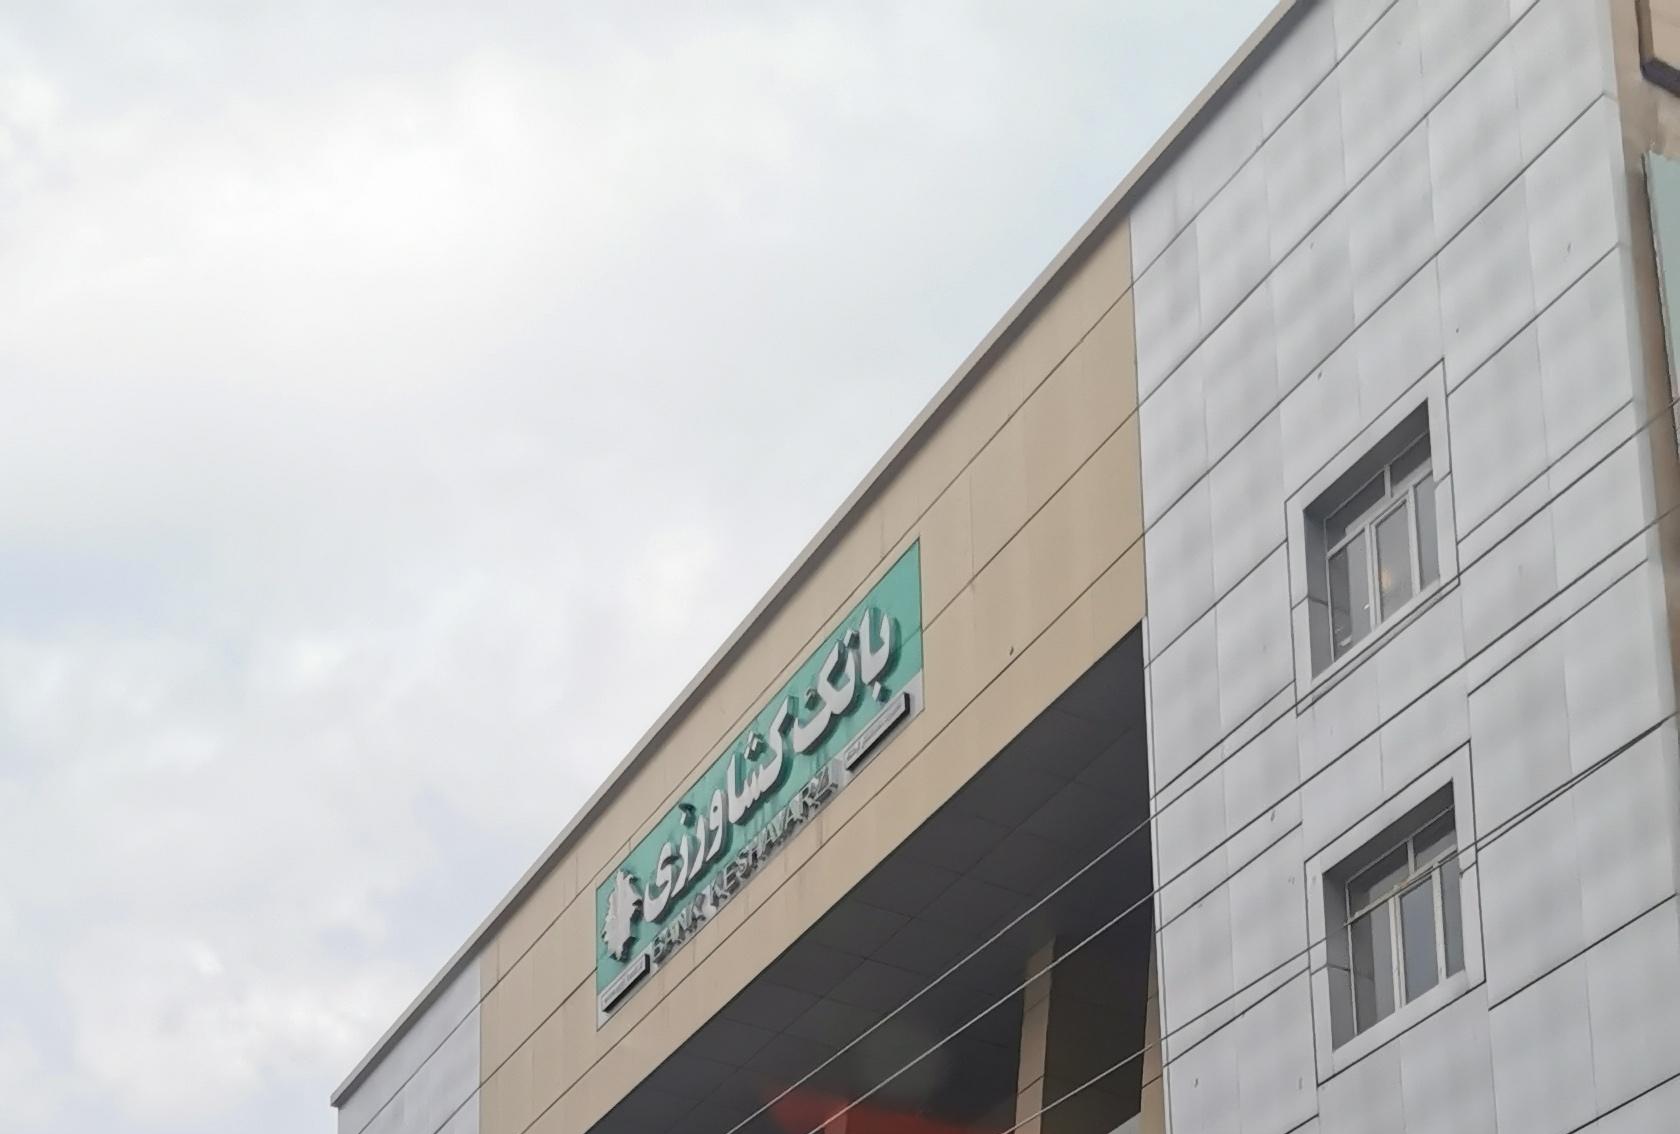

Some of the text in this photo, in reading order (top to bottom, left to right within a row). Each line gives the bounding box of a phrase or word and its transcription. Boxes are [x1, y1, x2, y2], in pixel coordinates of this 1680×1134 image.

[792, 606, 897, 757] بانک
[643, 695, 801, 923] کشاورزی
[651, 892, 708, 965] BANK
